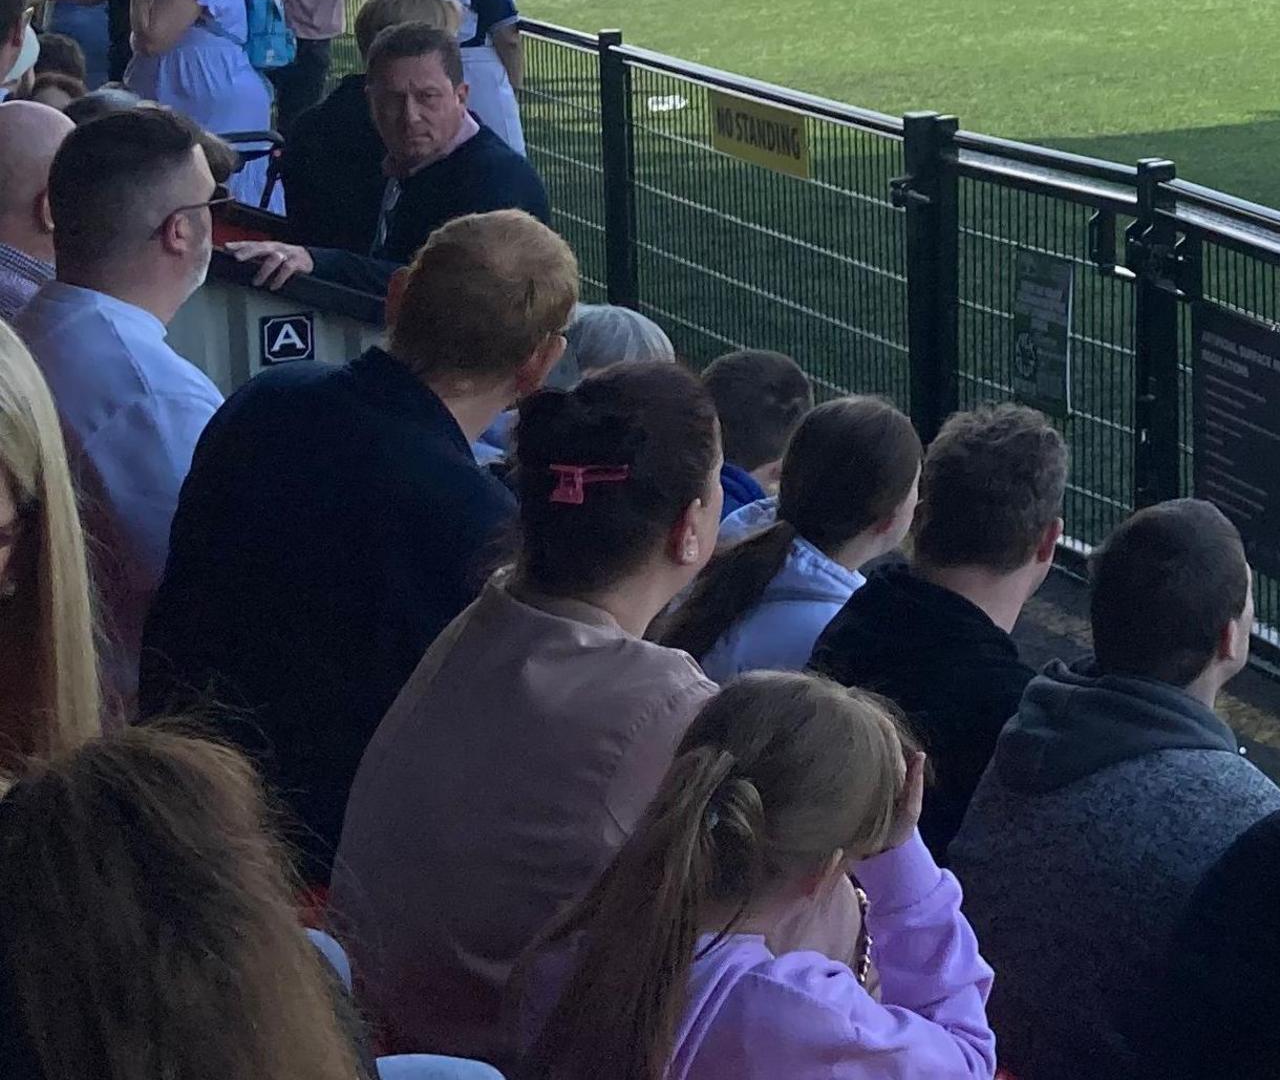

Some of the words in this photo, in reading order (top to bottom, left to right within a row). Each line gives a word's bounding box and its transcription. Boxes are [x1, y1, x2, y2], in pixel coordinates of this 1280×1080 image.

[717, 106, 733, 138] NO
[735, 111, 800, 160] STANDING
[270, 322, 305, 349] A
